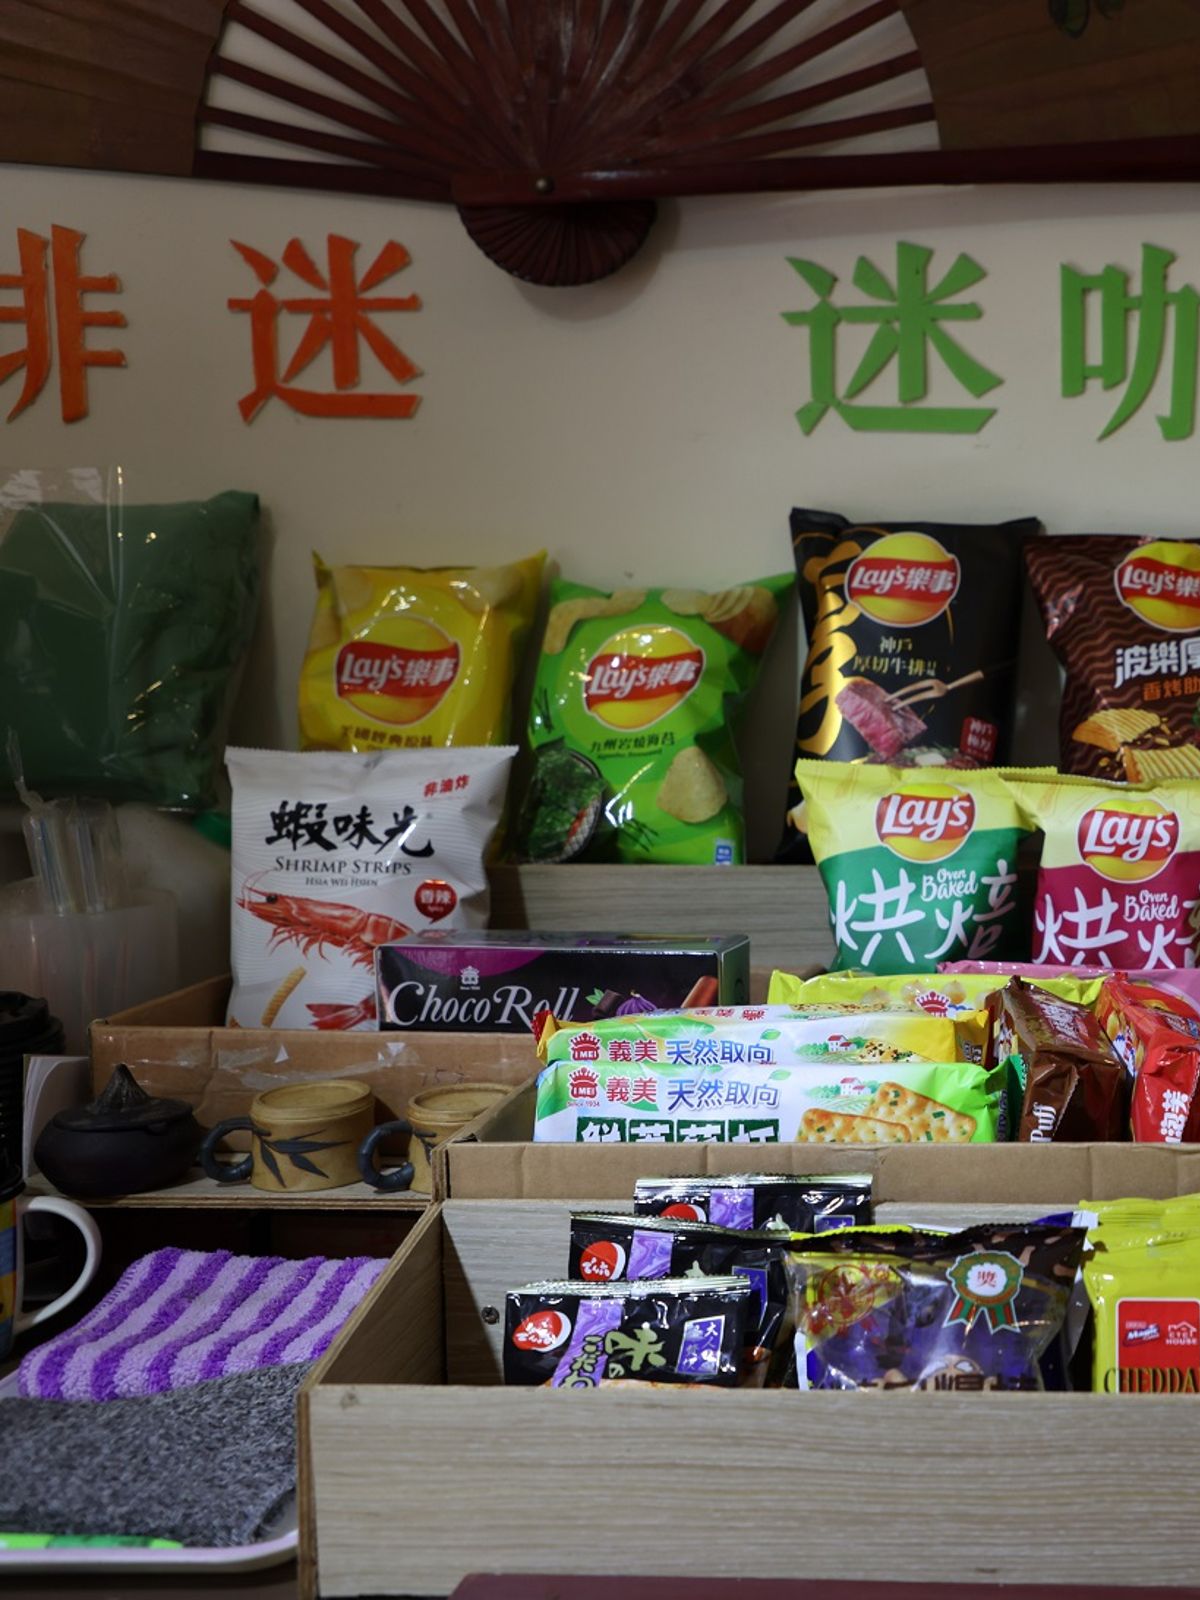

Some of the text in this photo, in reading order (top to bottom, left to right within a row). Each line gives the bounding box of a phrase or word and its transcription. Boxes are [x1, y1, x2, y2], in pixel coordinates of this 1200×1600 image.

[423, 774, 470, 797] 非油炸
[265, 800, 435, 858] 蝦味先
[881, 793, 970, 842] Lay's
[1084, 811, 1175, 862] Lay's
[274, 856, 412, 876] SHRIMP STRIPS
[936, 867, 967, 884] Oven
[420, 888, 450, 905] 香辣
[921, 876, 977, 902] Baked
[1139, 889, 1169, 905] Oven
[1124, 895, 1179, 923] Baked
[390, 981, 580, 1028] Choco Roll
[609, 1039, 773, 1065] 義美 天然取向
[606, 1077, 779, 1112] 義美 天然取向
